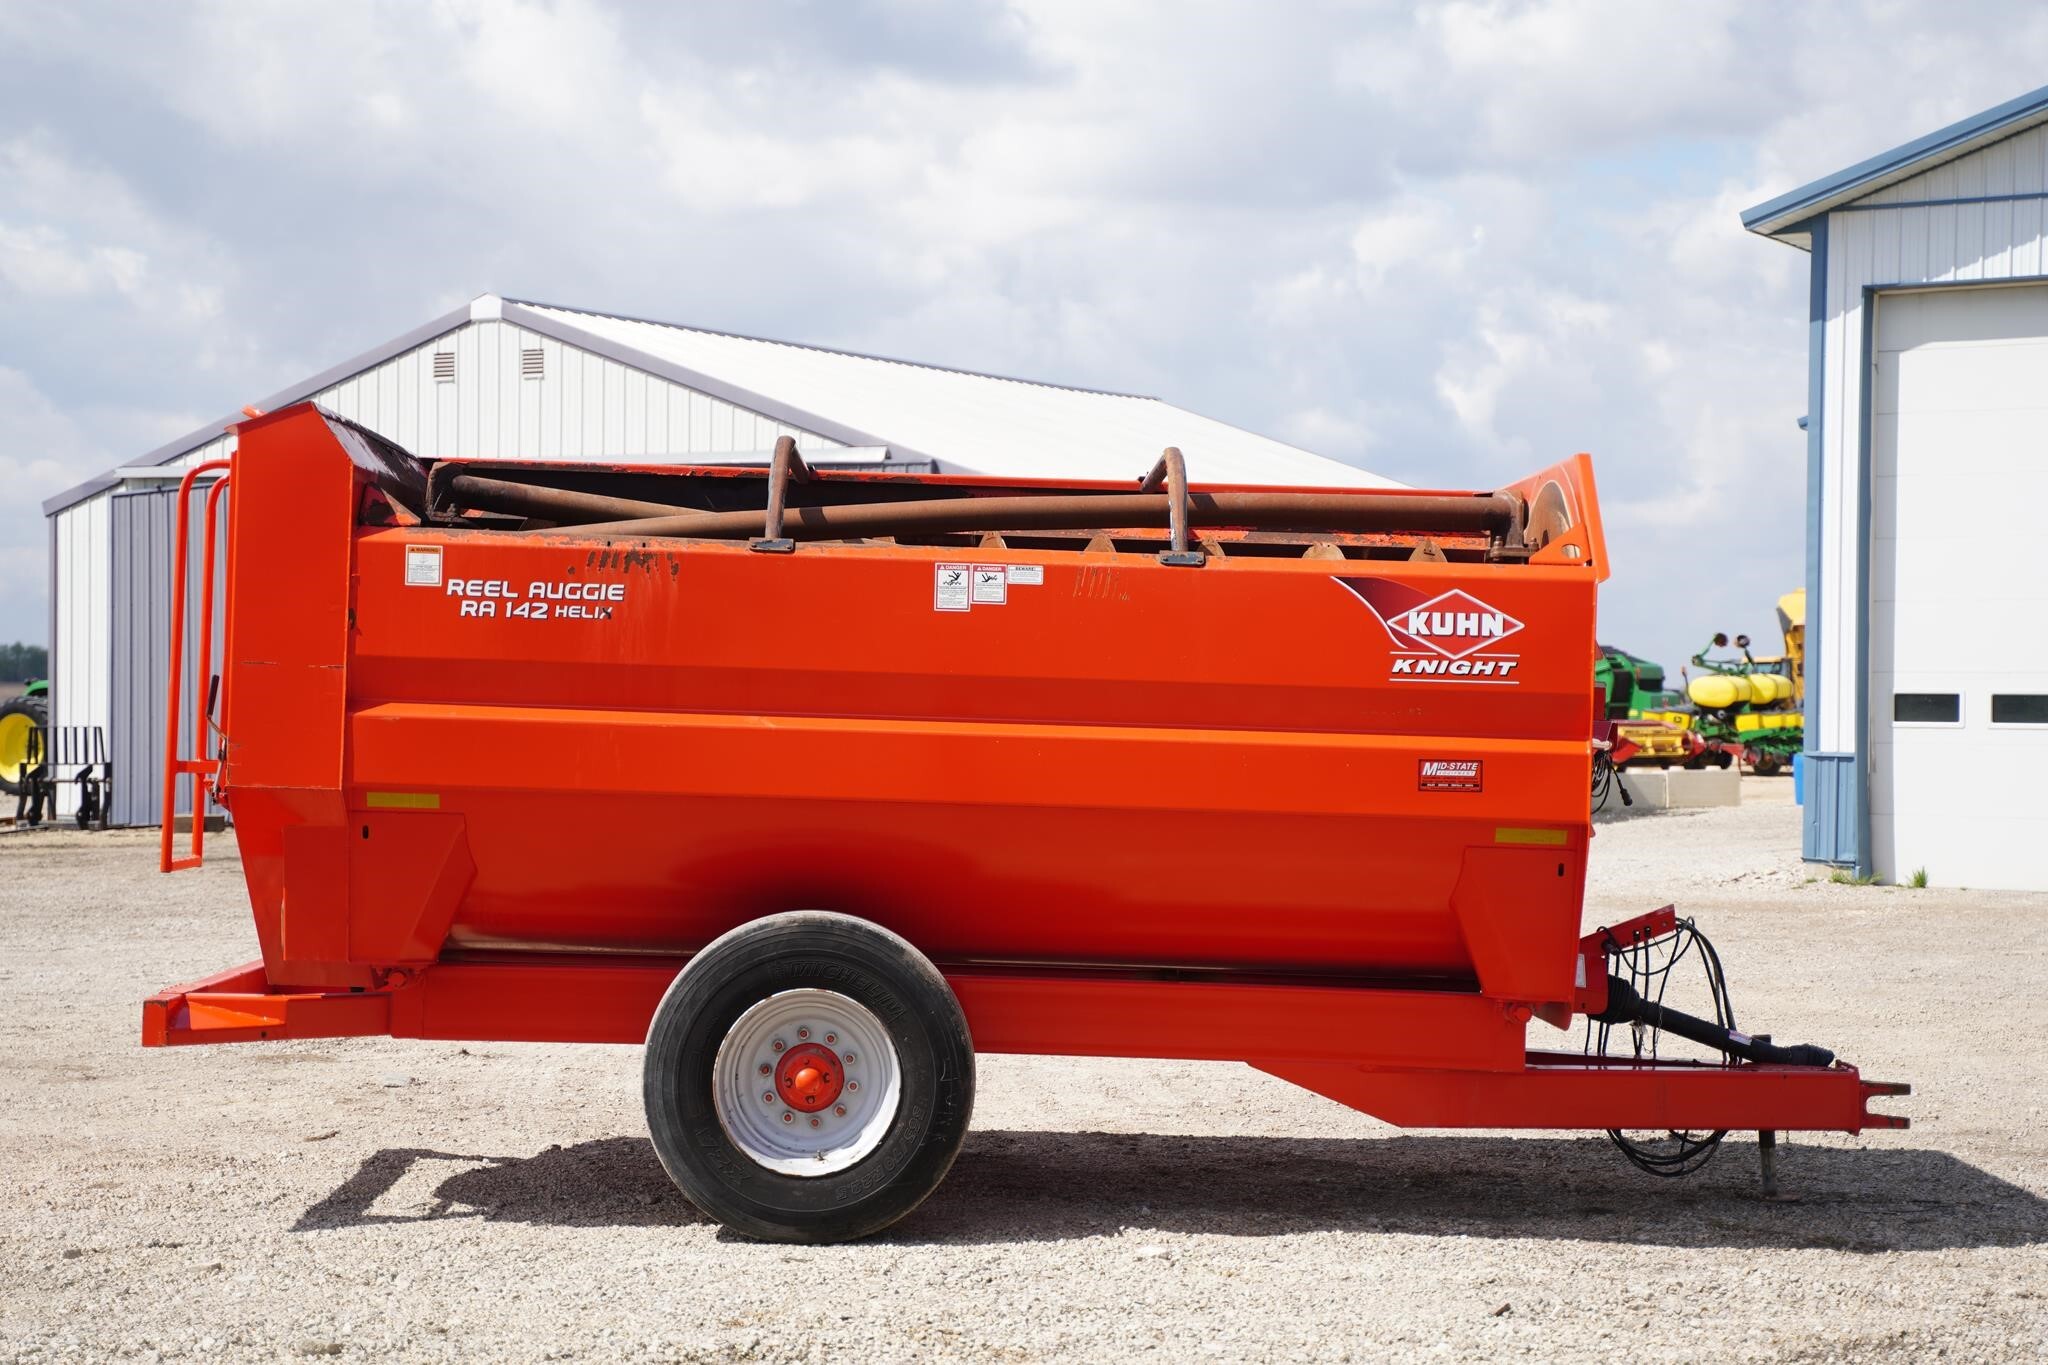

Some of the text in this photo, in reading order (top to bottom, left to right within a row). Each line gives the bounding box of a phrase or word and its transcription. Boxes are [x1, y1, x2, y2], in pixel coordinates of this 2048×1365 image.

[446, 578, 625, 601] REEL AUGGIE
[460, 600, 613, 620] RA 142 HELIX
[1407, 611, 1505, 637] KUHN
[1391, 659, 1518, 676] KNIGHT
[1422, 761, 1478, 776] MID-STATE
[790, 961, 903, 1021] MICHELIN
